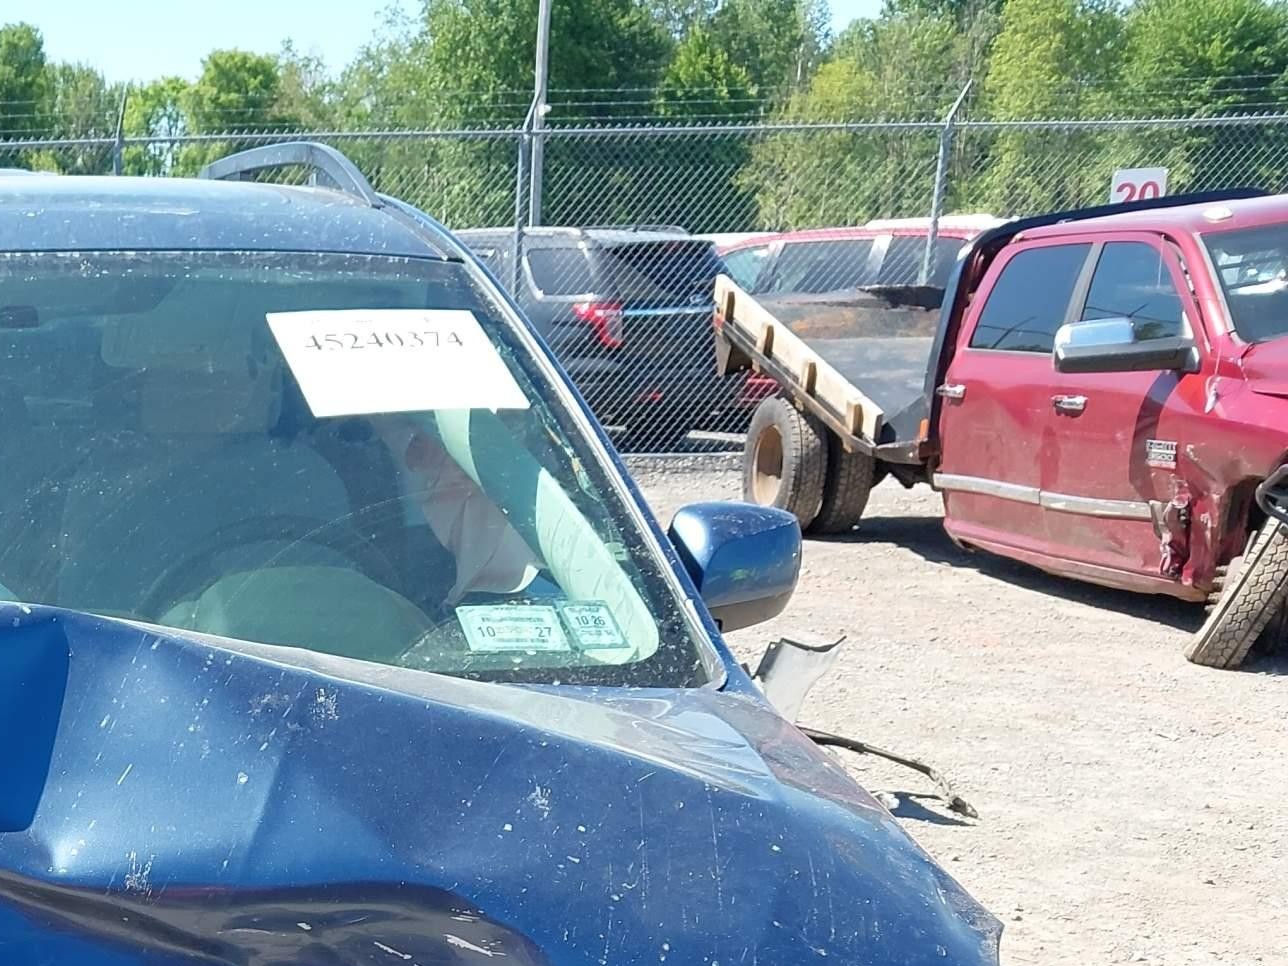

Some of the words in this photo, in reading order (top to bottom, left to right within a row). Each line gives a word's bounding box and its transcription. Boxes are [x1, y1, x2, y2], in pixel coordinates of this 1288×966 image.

[304, 331, 464, 350] 45240374
[576, 615, 589, 626] 10
[477, 625, 496, 638] 10
[535, 626, 552, 638] 27
